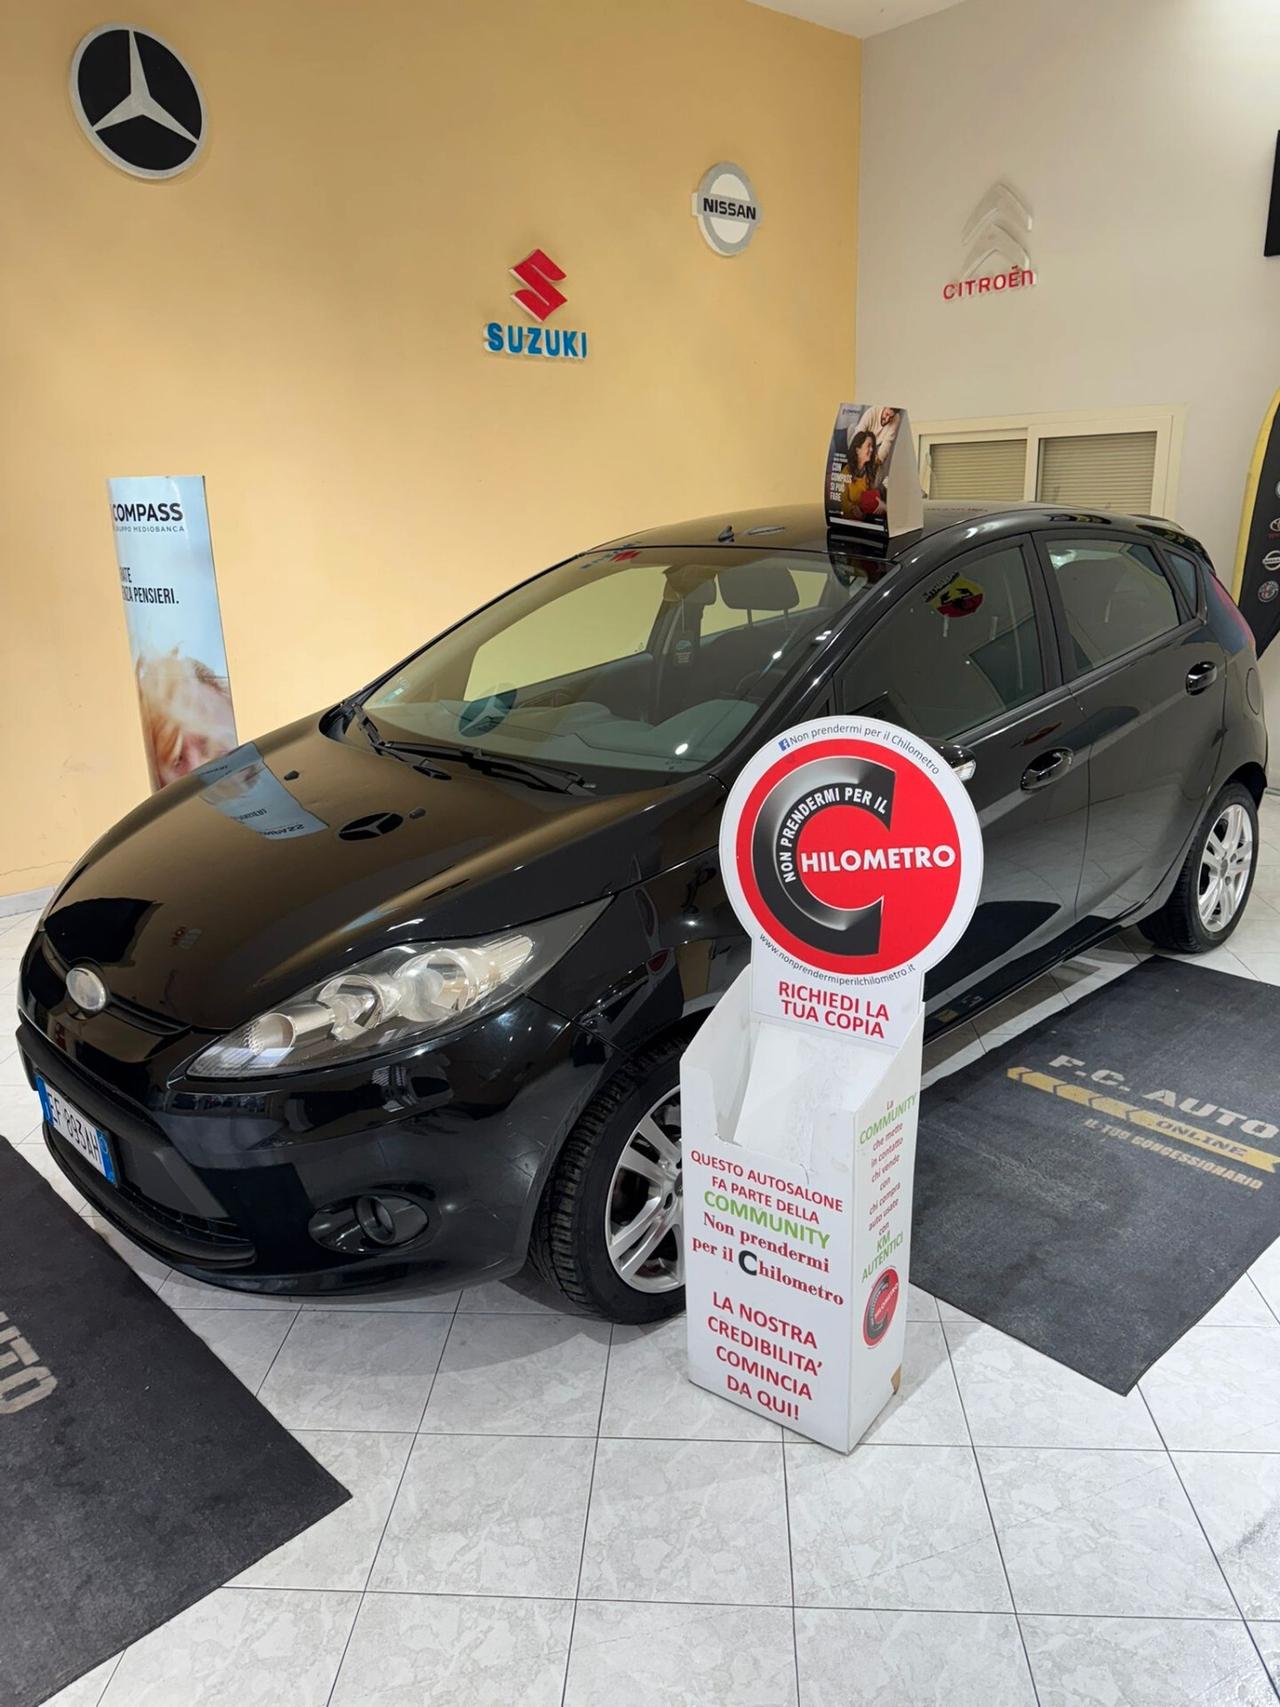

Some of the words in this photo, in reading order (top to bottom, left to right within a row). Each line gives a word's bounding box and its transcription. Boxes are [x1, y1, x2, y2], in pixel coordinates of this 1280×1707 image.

[703, 197, 756, 220] NISSAN
[486, 322, 588, 359] SUZUKI
[133, 525, 185, 533] MEDIOBANCA
[133, 587, 180, 605] PENSIERI.
[789, 732, 810, 745] Non
[811, 724, 862, 740] prendermi
[864, 727, 881, 738] per
[883, 731, 891, 741] il
[891, 735, 939, 775] Chilometro
[780, 787, 840, 847] PRENDERMI
[844, 787, 873, 806] PER
[874, 796, 888, 815] IL
[779, 852, 796, 883] NON
[760, 933, 917, 986] www.nonprendermiperilchilometro.it
[778, 981, 860, 1013] RICHIEDI
[866, 1001, 890, 1021] LA
[781, 999, 819, 1022] TUA
[825, 1010, 885, 1038] COPIA
[860, 1092, 918, 1145] COMMUNITY
[1142, 1089, 1280, 1139] AUTO
[1154, 1119, 1248, 1158] ONLINE
[691, 1150, 744, 1177] QUESTO
[747, 1169, 844, 1213] AUTOSALONE
[1131, 1136, 1264, 1191] CONCESSIONARIO
[704, 1190, 831, 1249] COMMUNITY
[712, 1176, 727, 1191] FA
[731, 1183, 772, 1207] PARTE
[776, 1198, 820, 1224] DELLA
[703, 1211, 735, 1237] Non
[740, 1230, 830, 1274] prendermi
[876, 1231, 891, 1253] KM
[692, 1237, 718, 1256] per
[722, 1246, 734, 1263] il
[738, 1250, 844, 1306] Chilometro
[713, 1291, 734, 1315] LA
[739, 1303, 818, 1350] NOSTRA
[716, 1345, 813, 1401] COMINCIA
[727, 1374, 752, 1400] DA
[757, 1390, 799, 1421] QUI!
